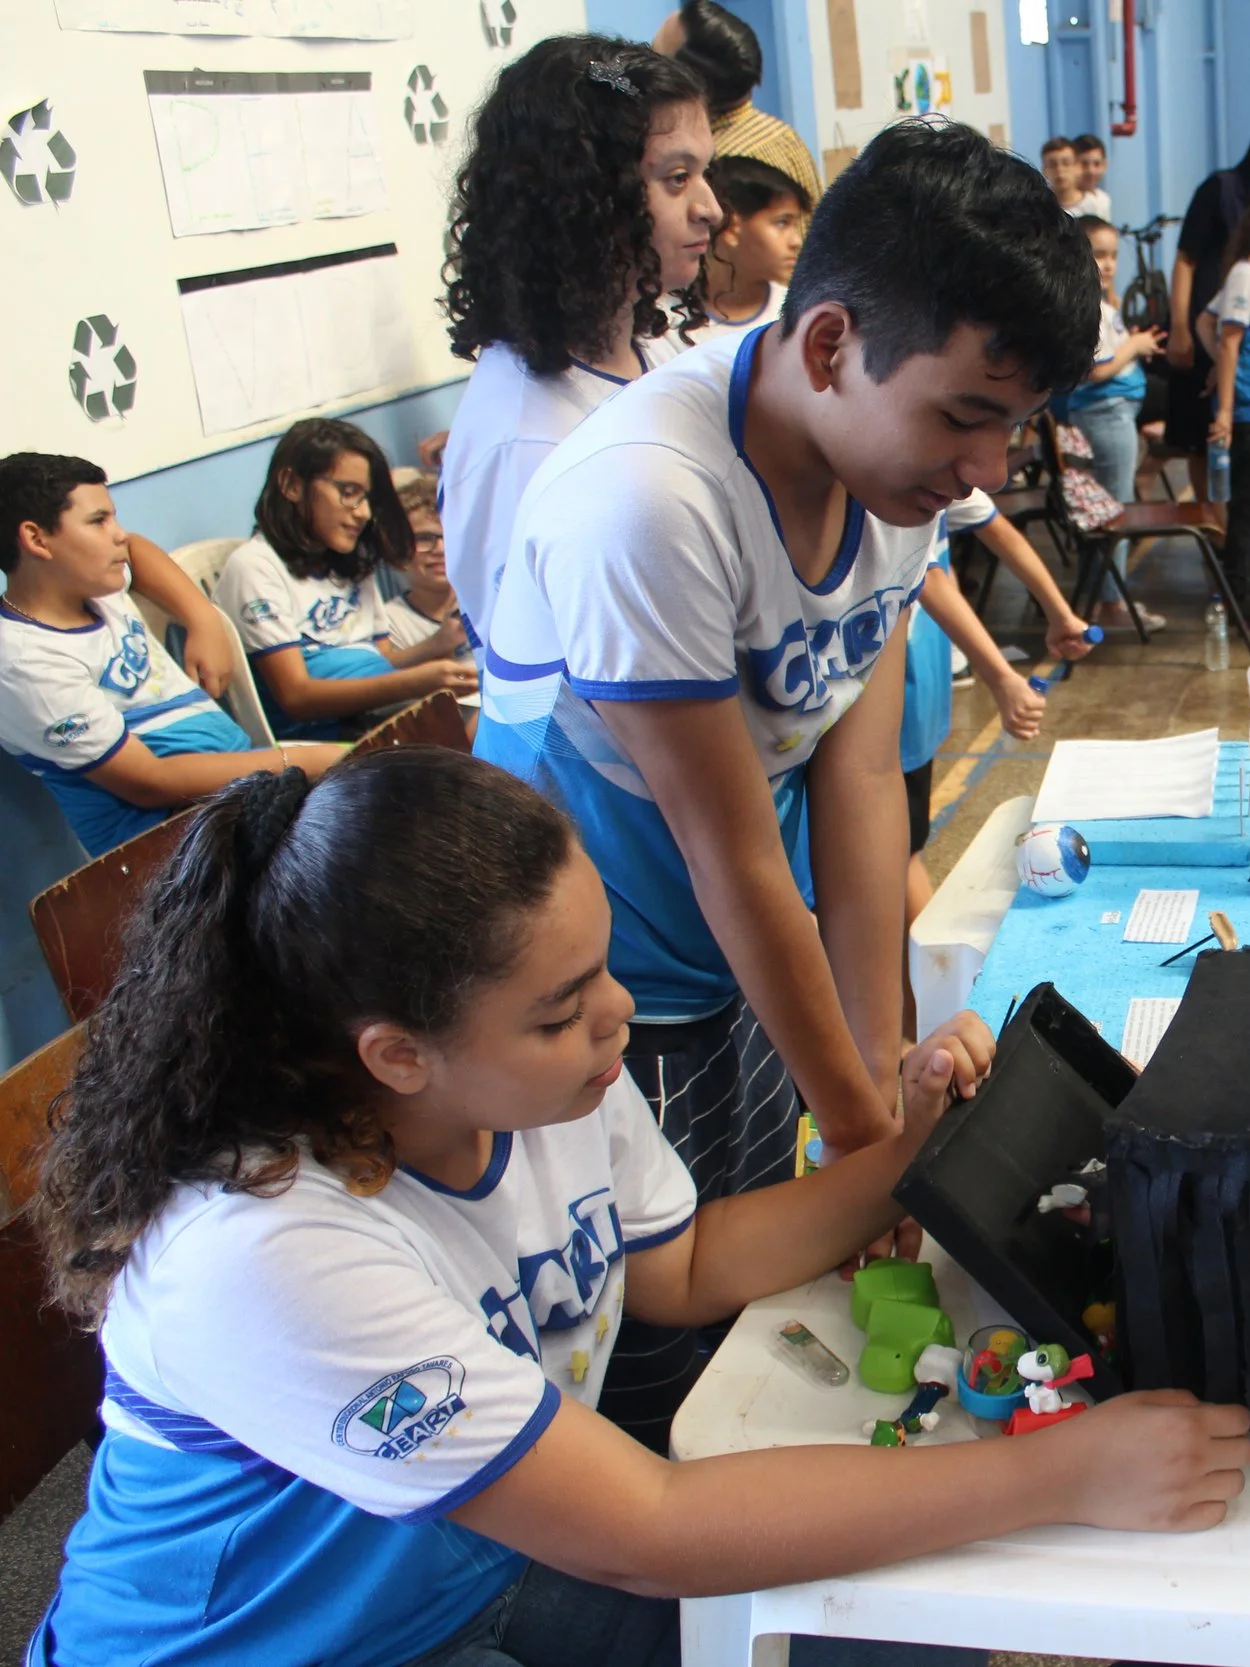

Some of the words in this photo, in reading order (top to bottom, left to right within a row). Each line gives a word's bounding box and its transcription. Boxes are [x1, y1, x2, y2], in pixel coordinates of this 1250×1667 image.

[751, 586, 906, 712] CART
[366, 1378, 393, 1403] ANTONIO
[422, 1359, 454, 1371] TAVARES
[373, 1391, 467, 1461] CEART
